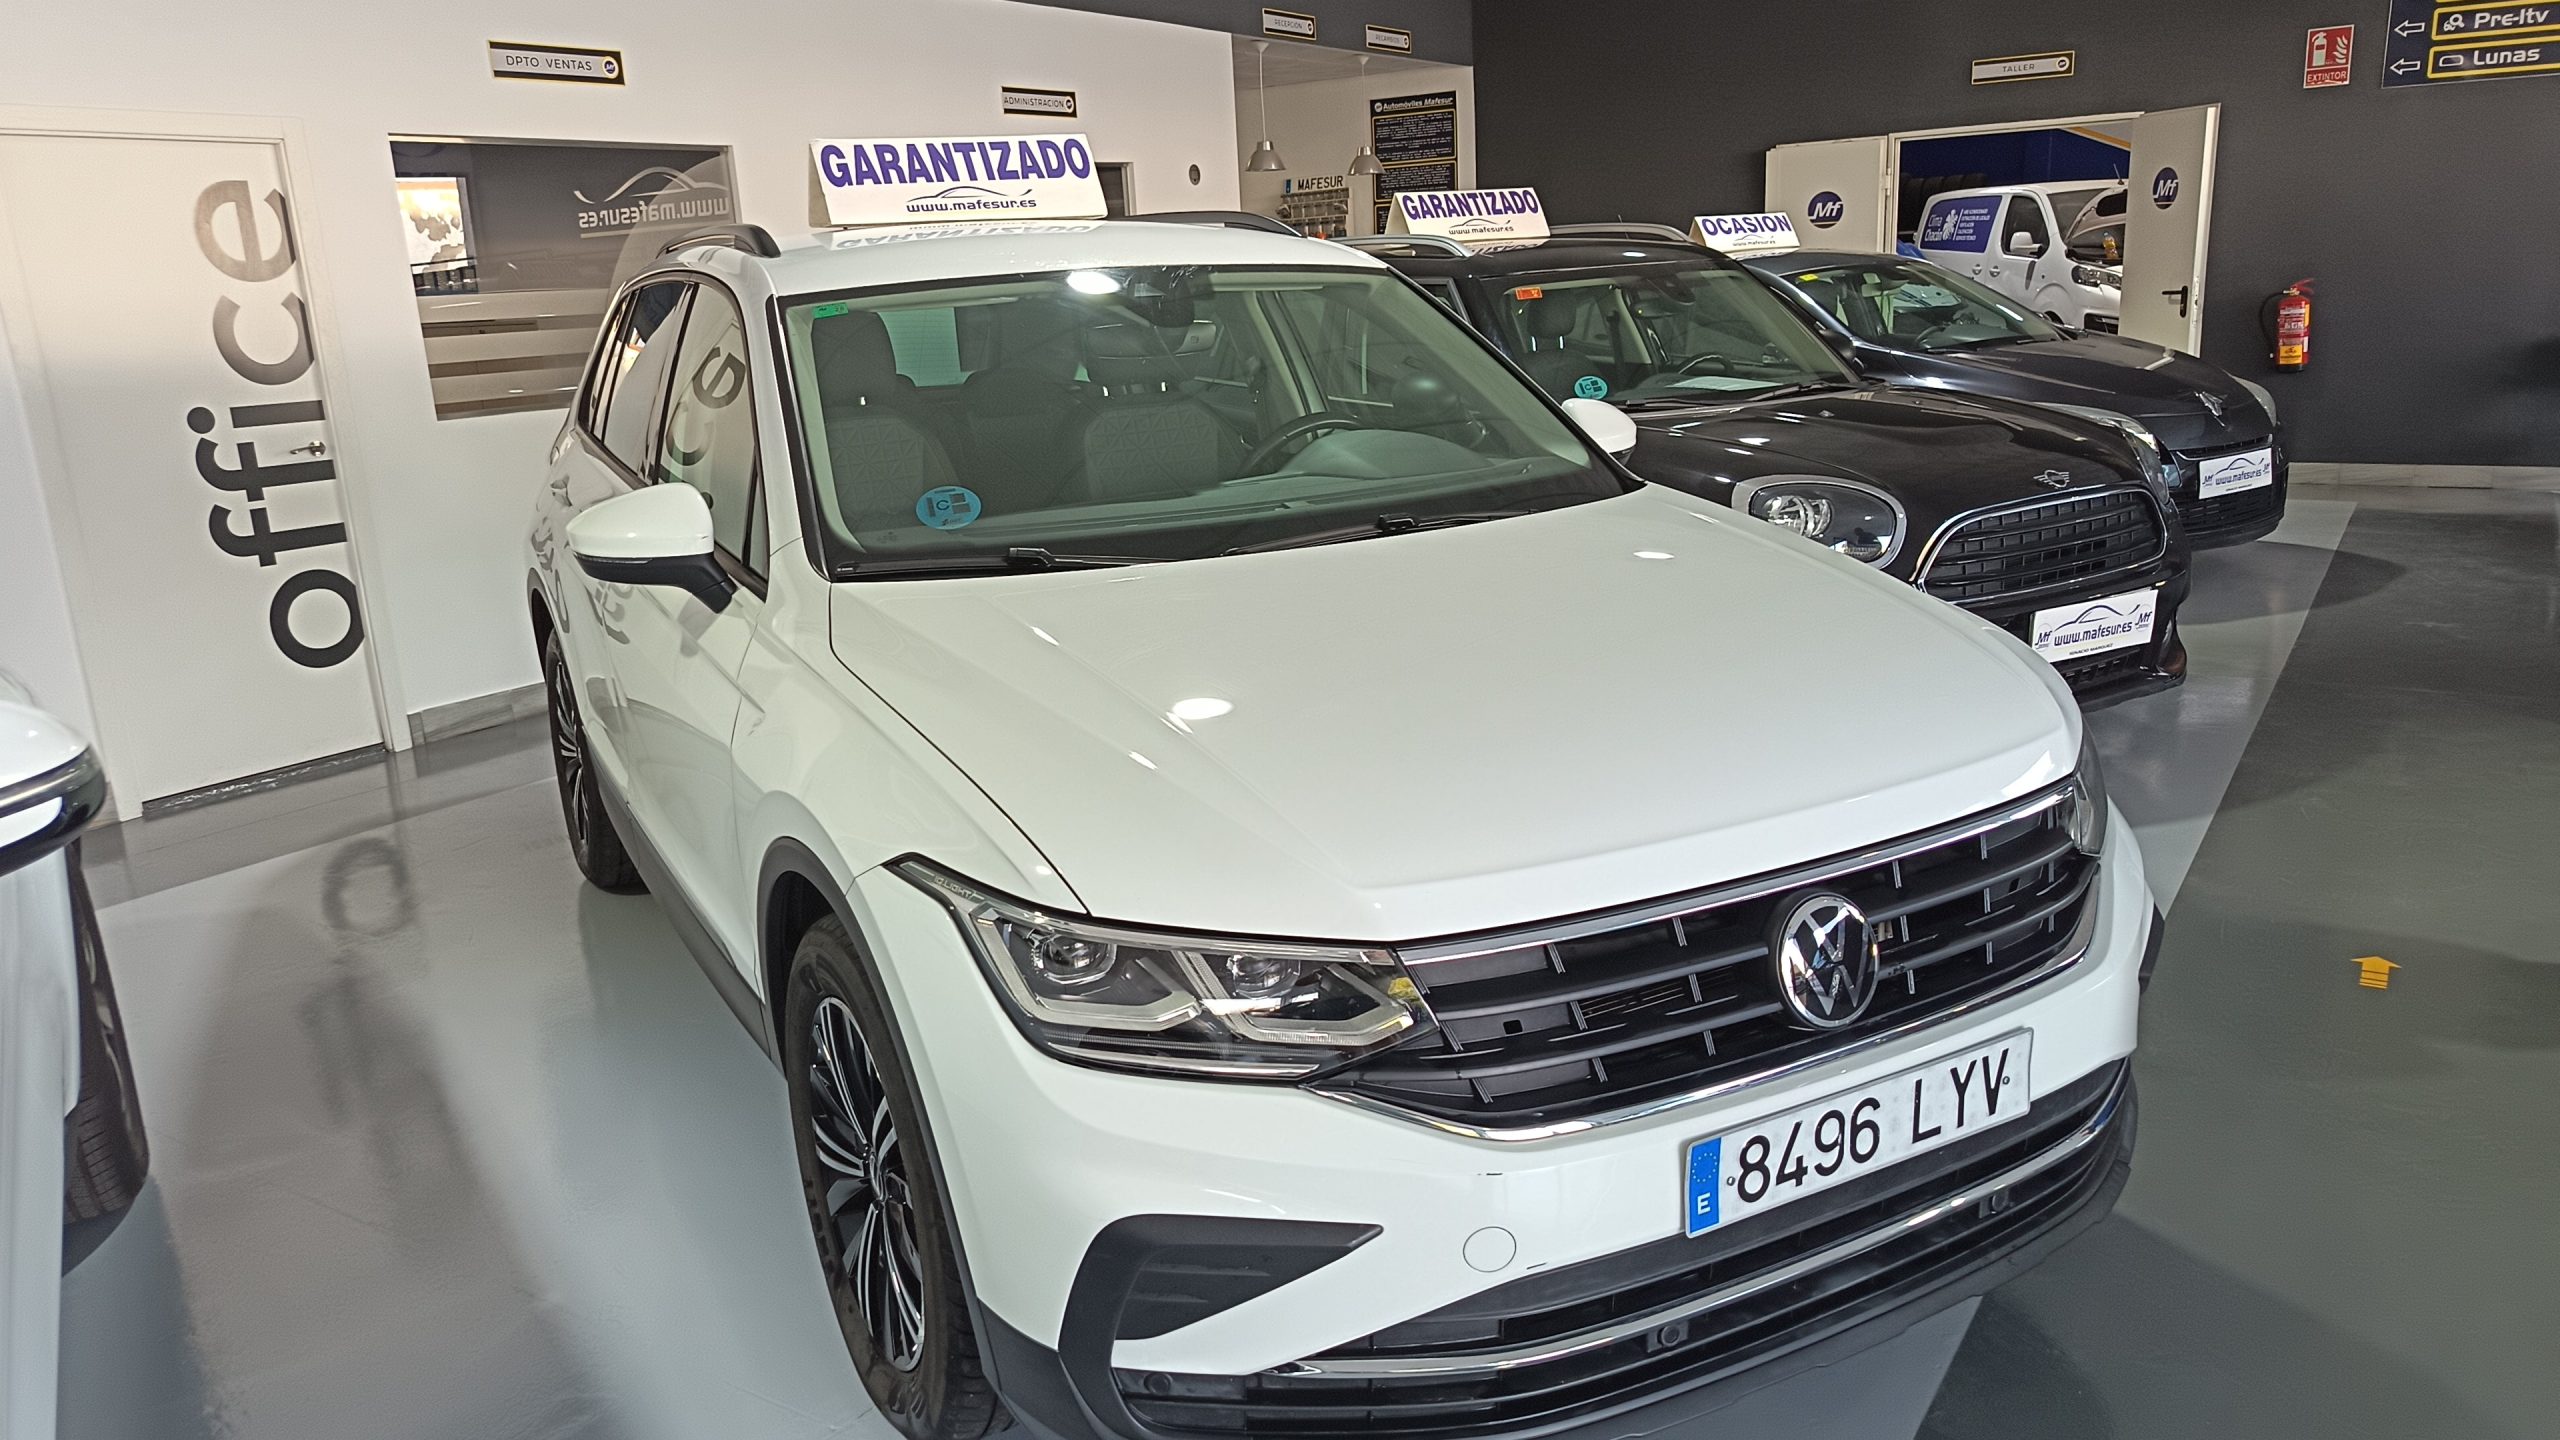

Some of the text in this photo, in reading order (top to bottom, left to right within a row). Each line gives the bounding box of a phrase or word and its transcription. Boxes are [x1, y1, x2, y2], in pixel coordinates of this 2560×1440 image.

[2474, 8, 2550, 28] Pre-Itv
[505, 55, 592, 71] DPTO VENTAS
[2473, 48, 2541, 66] Lunas
[2002, 63, 2035, 73] TALLER
[2306, 71, 2347, 83] EXTINTOR
[820, 138, 1091, 188] GARANTIZADO
[1297, 175, 1344, 191] MAFESUR
[906, 197, 1037, 213] www.mafesur.es
[1402, 189, 1539, 221] GARANTIZADO
[1701, 215, 1792, 236] OCASION
[186, 178, 366, 669] office
[936, 499, 950, 511] C
[2054, 621, 2133, 647] www.mafesur.es
[1697, 1048, 2009, 1215] E 8496 LYV
